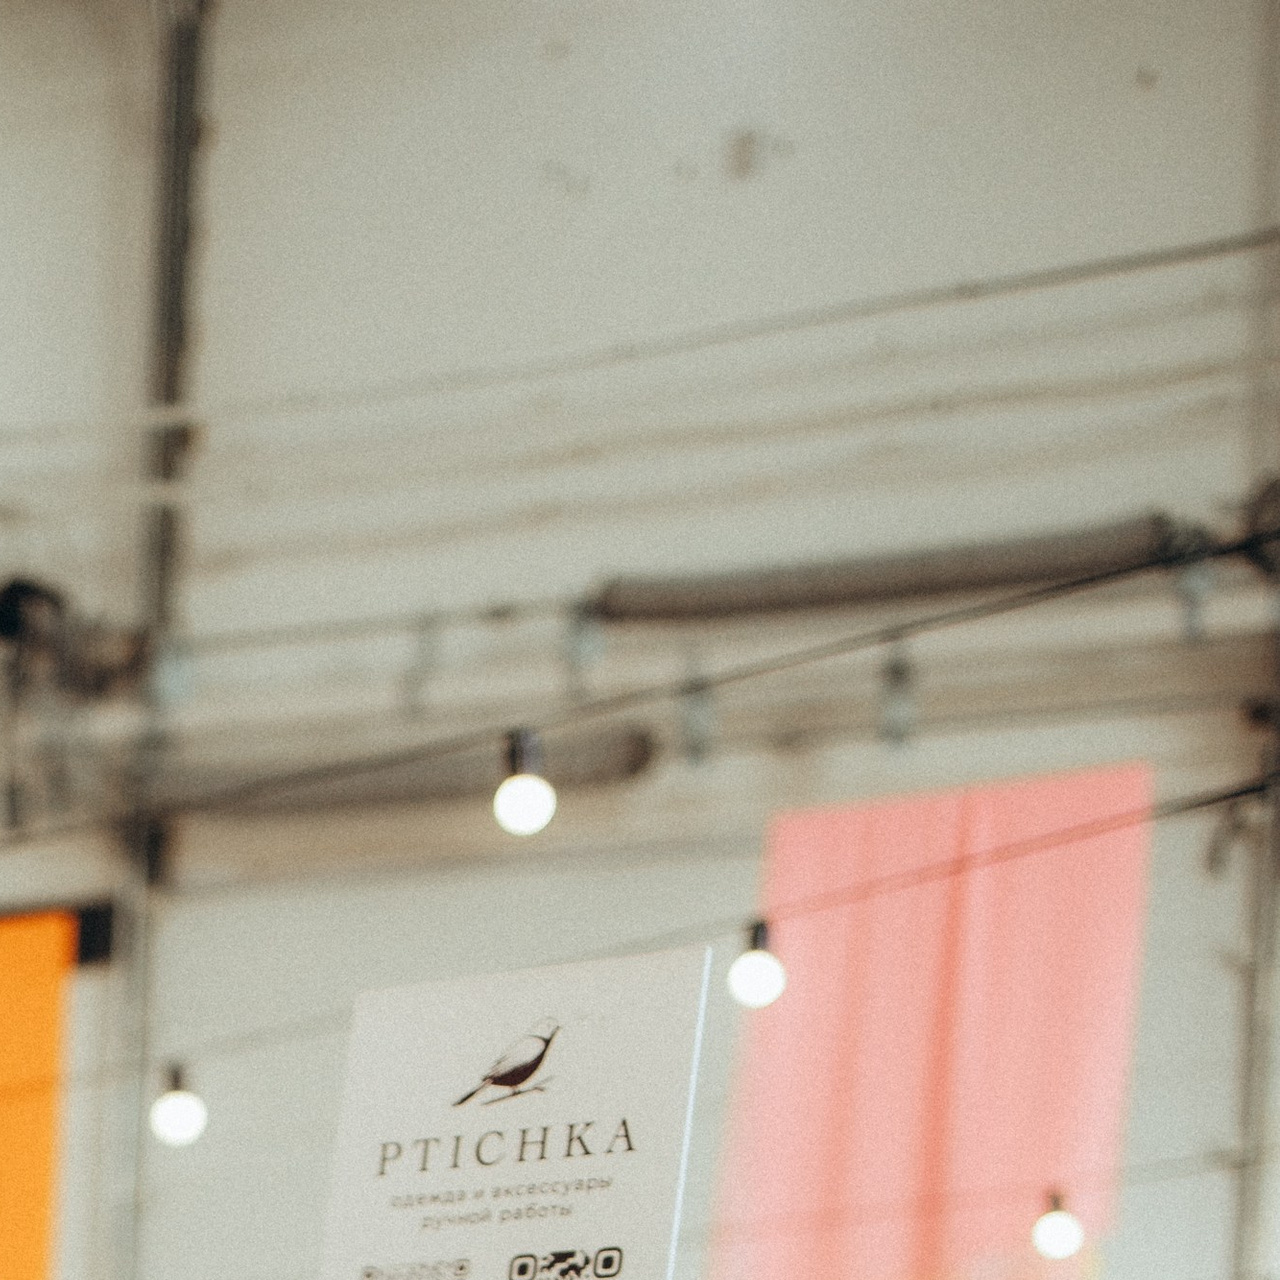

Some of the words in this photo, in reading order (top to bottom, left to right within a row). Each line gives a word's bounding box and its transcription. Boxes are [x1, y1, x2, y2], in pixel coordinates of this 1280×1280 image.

[377, 1117, 636, 1176] PTICHKA
[391, 1188, 466, 1208] одежда
[491, 1176, 612, 1200] аксессуары
[420, 1204, 493, 1231] ручной
[498, 1202, 573, 1224] работы
